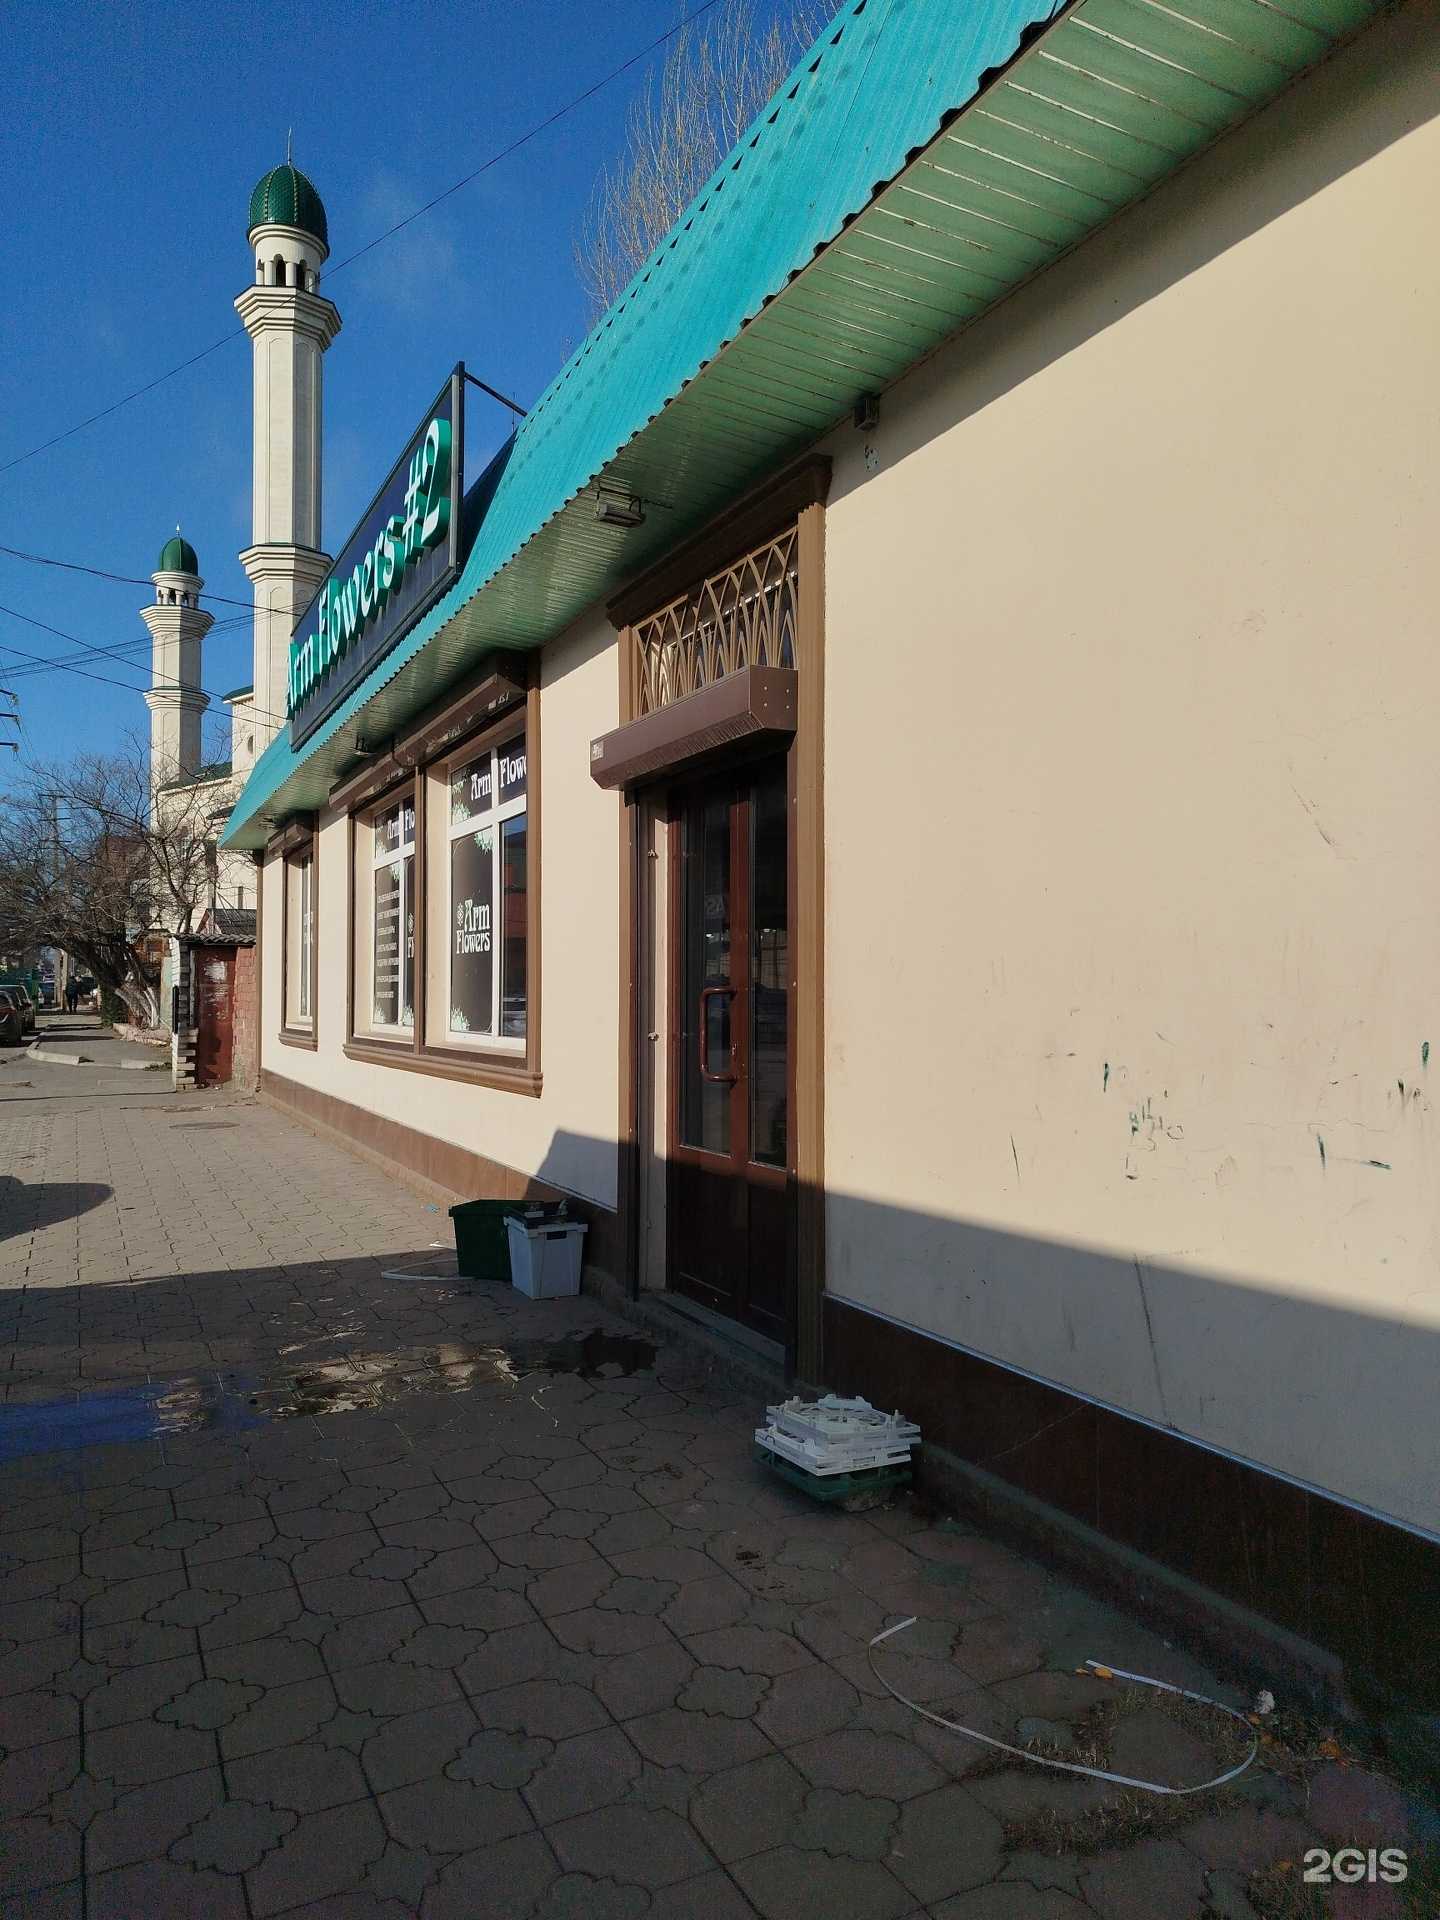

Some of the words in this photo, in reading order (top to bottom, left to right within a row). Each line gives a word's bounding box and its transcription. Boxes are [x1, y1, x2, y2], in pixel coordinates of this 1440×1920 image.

[318, 514, 403, 676] Flowers
[402, 418, 450, 562] #2
[471, 773, 491, 801] Arm
[500, 755, 527, 788] Flow
[464, 899, 490, 933] Arm
[456, 930, 490, 954] Flowers
